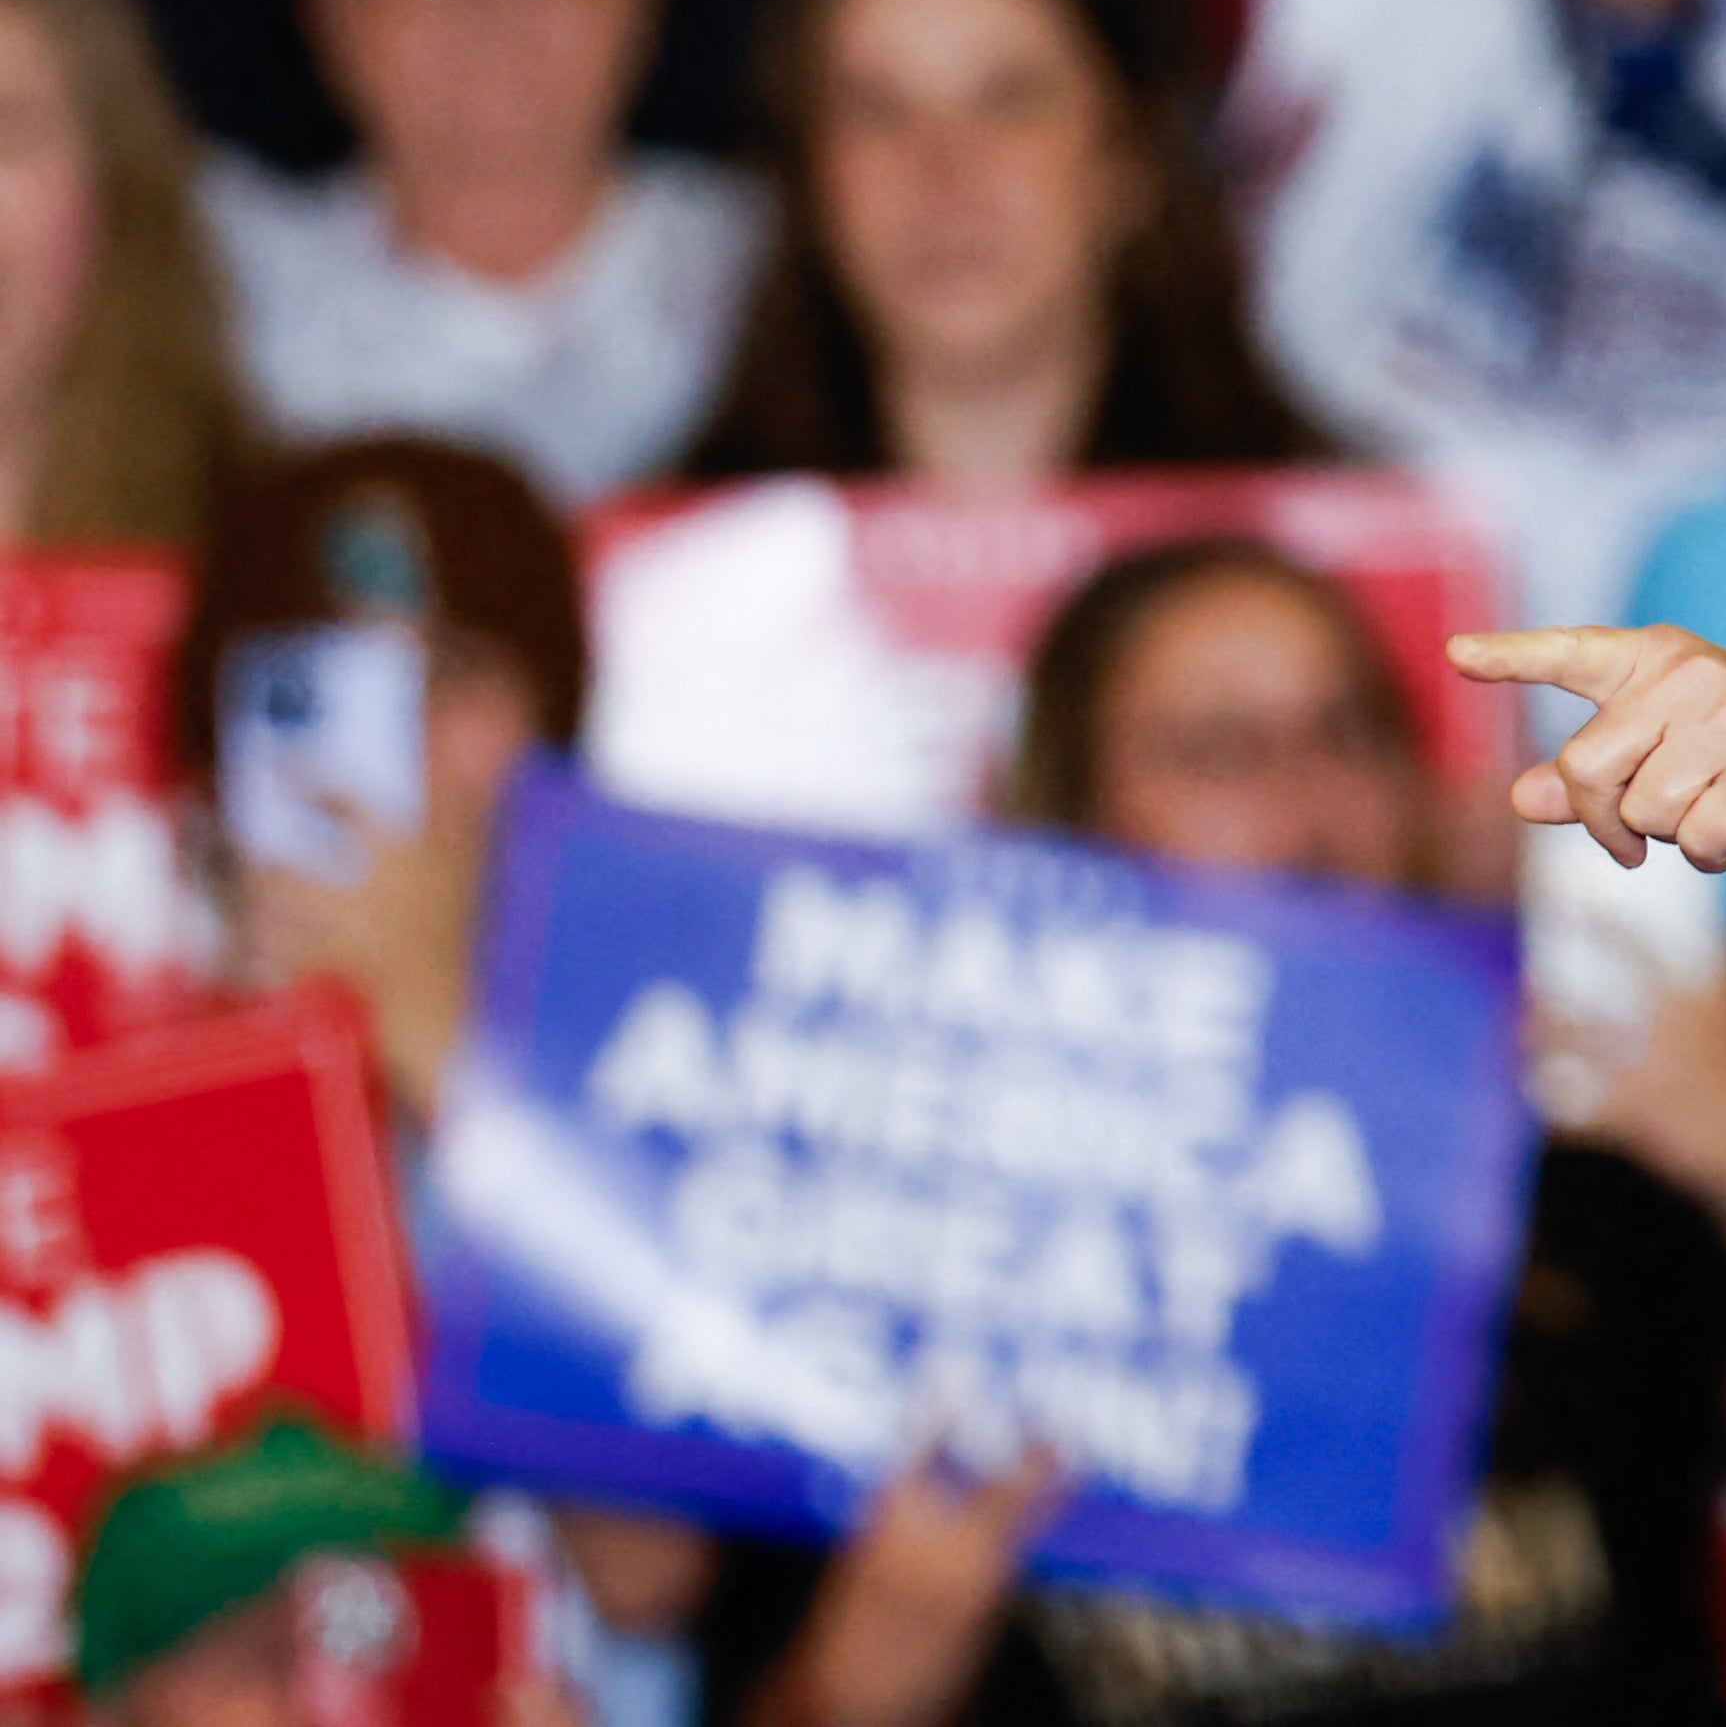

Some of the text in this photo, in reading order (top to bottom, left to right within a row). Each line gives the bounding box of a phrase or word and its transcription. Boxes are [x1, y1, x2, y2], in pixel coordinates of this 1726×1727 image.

[756, 871, 1274, 1063] MAKE
[592, 981, 1382, 1257] AMERICA
[668, 1153, 1274, 1351] GREAT
